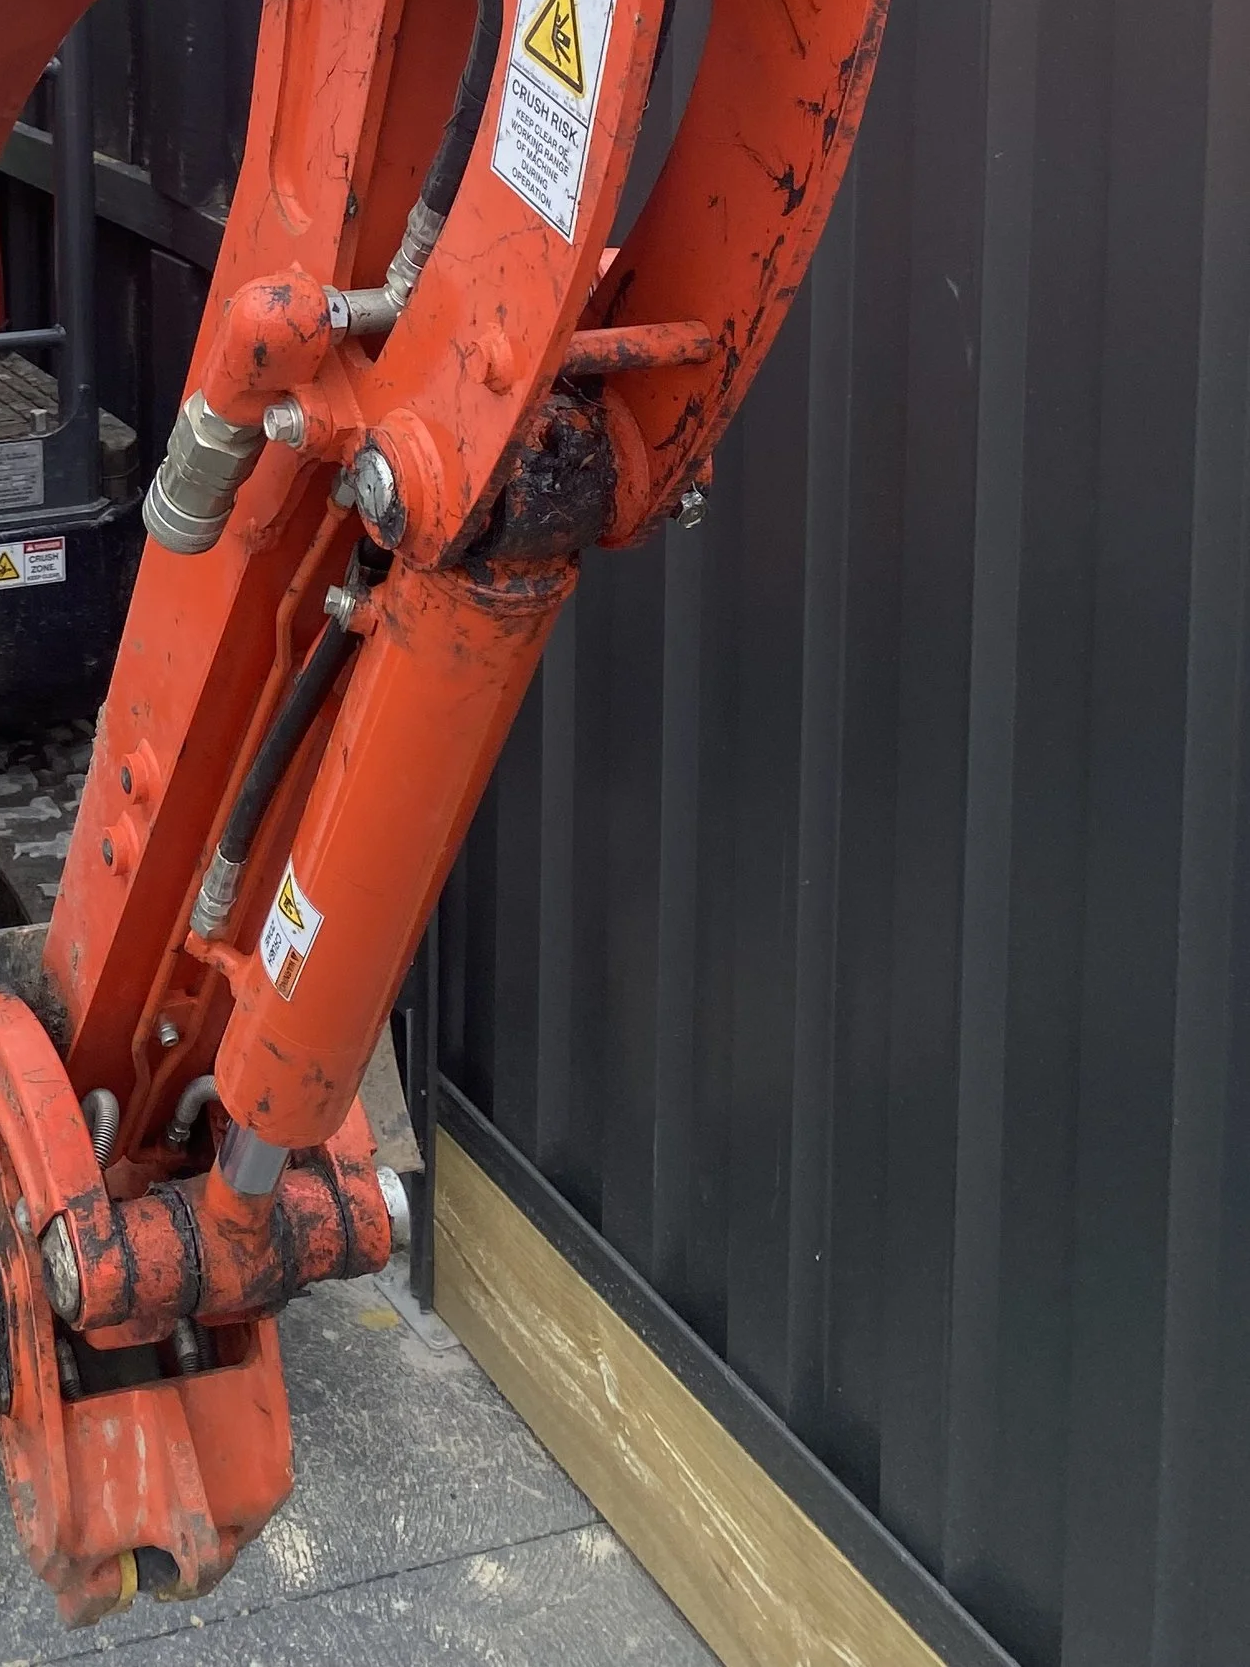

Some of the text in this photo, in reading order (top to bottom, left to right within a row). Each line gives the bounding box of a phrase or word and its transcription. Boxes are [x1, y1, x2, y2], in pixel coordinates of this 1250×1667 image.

[511, 78, 550, 122] CRUSH
[550, 113, 580, 149] RISK.
[515, 106, 535, 129] KEEP
[534, 123, 557, 153] CLEAR
[511, 118, 570, 177] WORKING RANGE
[516, 139, 559, 184] OF MACHINE
[511, 167, 553, 212] OPERATION.
[521, 158, 548, 191] DURING
[29, 553, 59, 564] CRUSH
